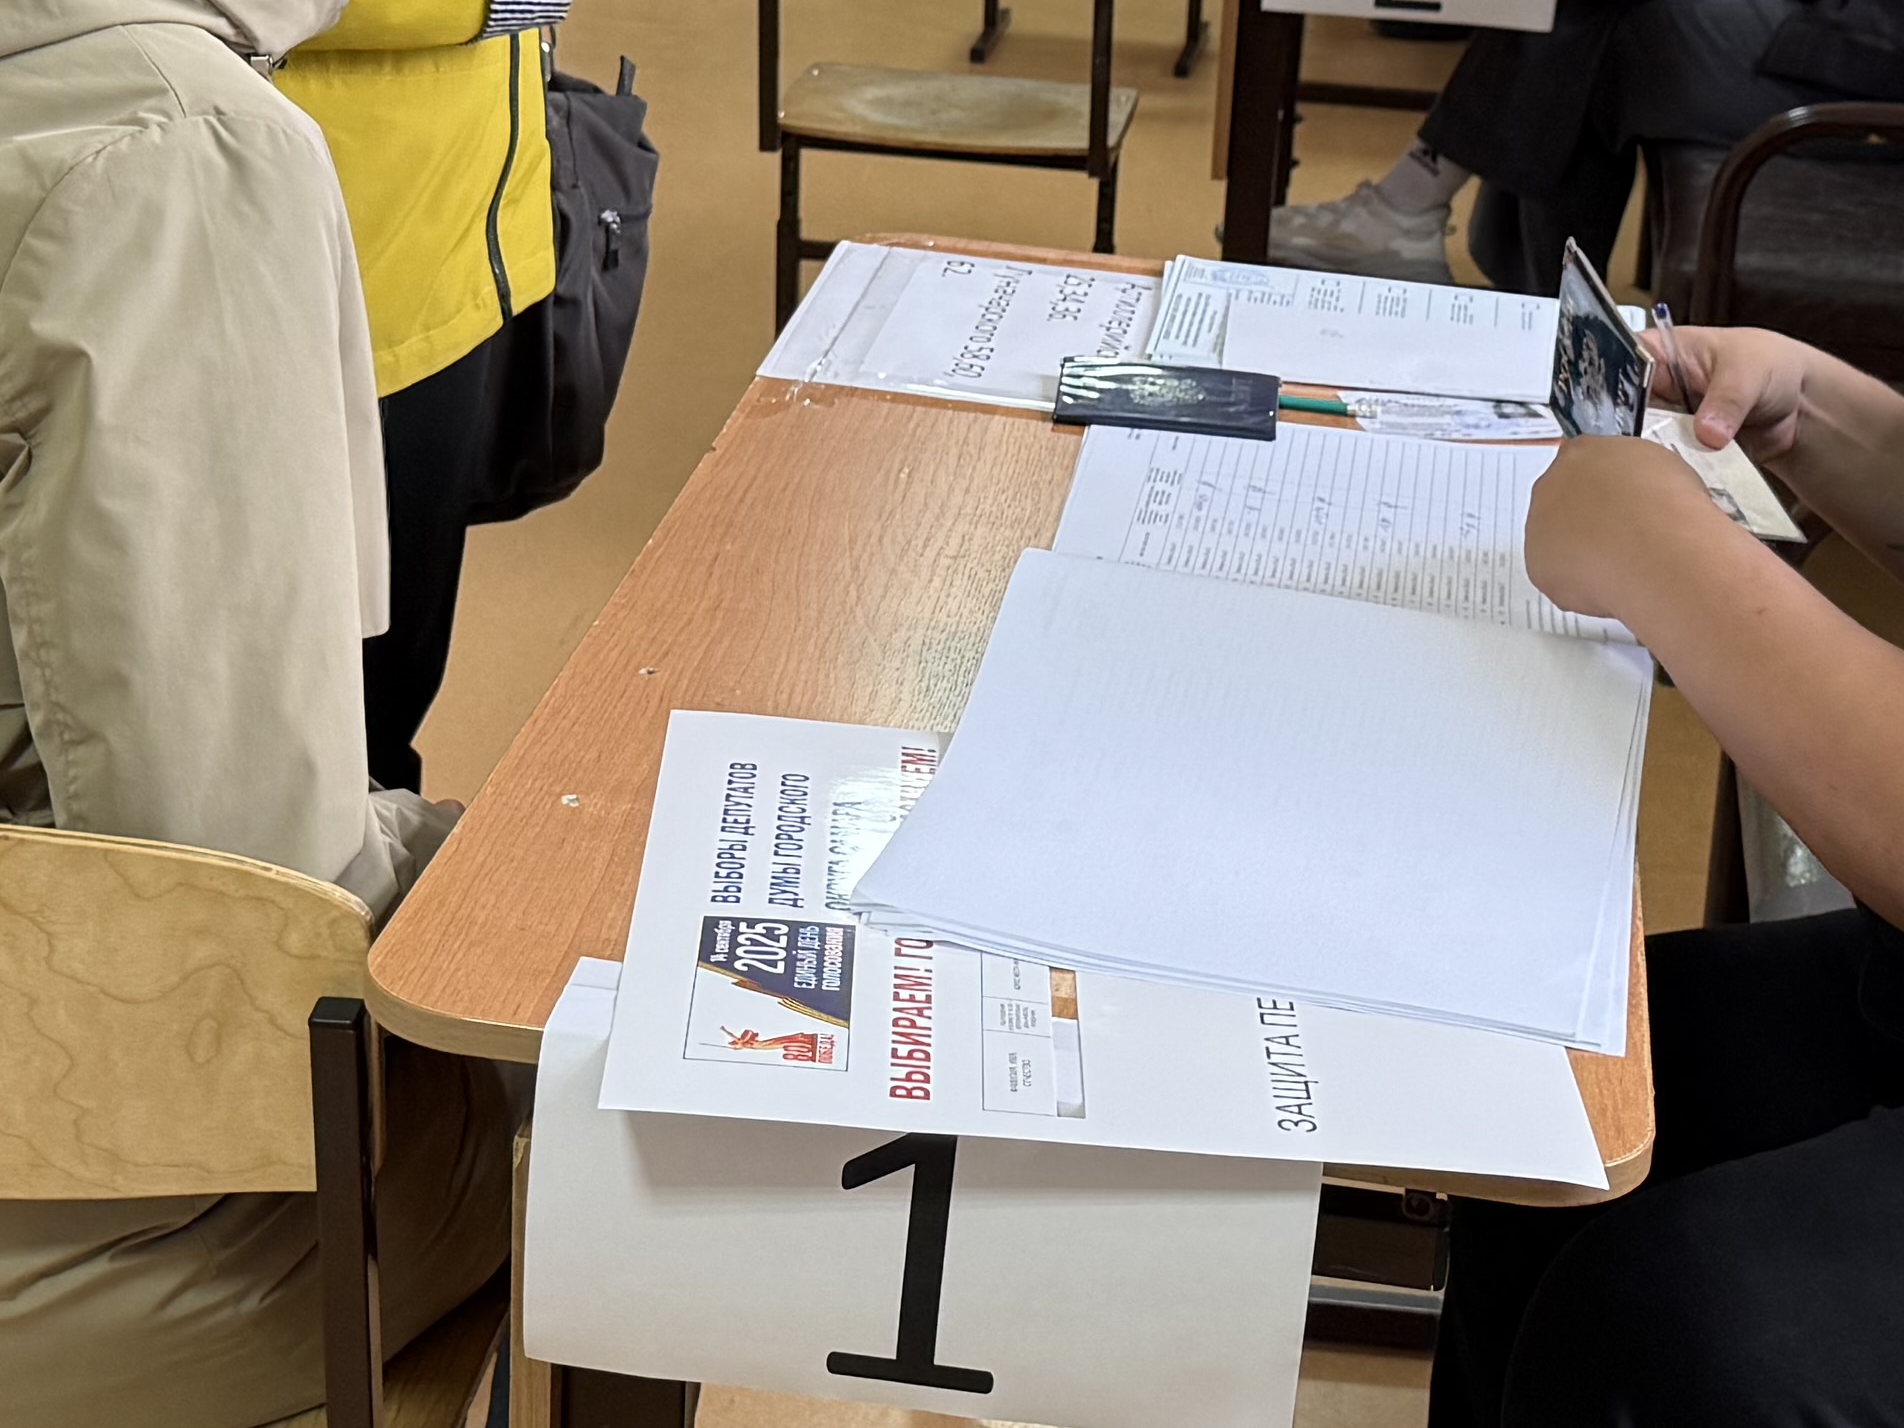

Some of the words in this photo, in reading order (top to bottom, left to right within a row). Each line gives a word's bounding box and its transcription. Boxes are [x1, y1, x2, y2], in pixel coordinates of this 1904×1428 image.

[970, 265, 1033, 343] Луначарского
[721, 762, 757, 836] ДЕПУТАТОВ
[774, 773, 810, 858] ГОРОДСКОГО
[711, 840, 747, 904] ВЫБОРЫ
[768, 859, 805, 909] ДУМЫ
[733, 922, 790, 974] 2025
[793, 951, 818, 989] ЕДИНЫЙ
[798, 925, 821, 949] ДЕНЬ
[889, 964, 934, 1101] ВЫБИРАЕМ!
[1264, 1034, 1319, 1133] ЗАЩИТА
[826, 1133, 993, 1394] 1
